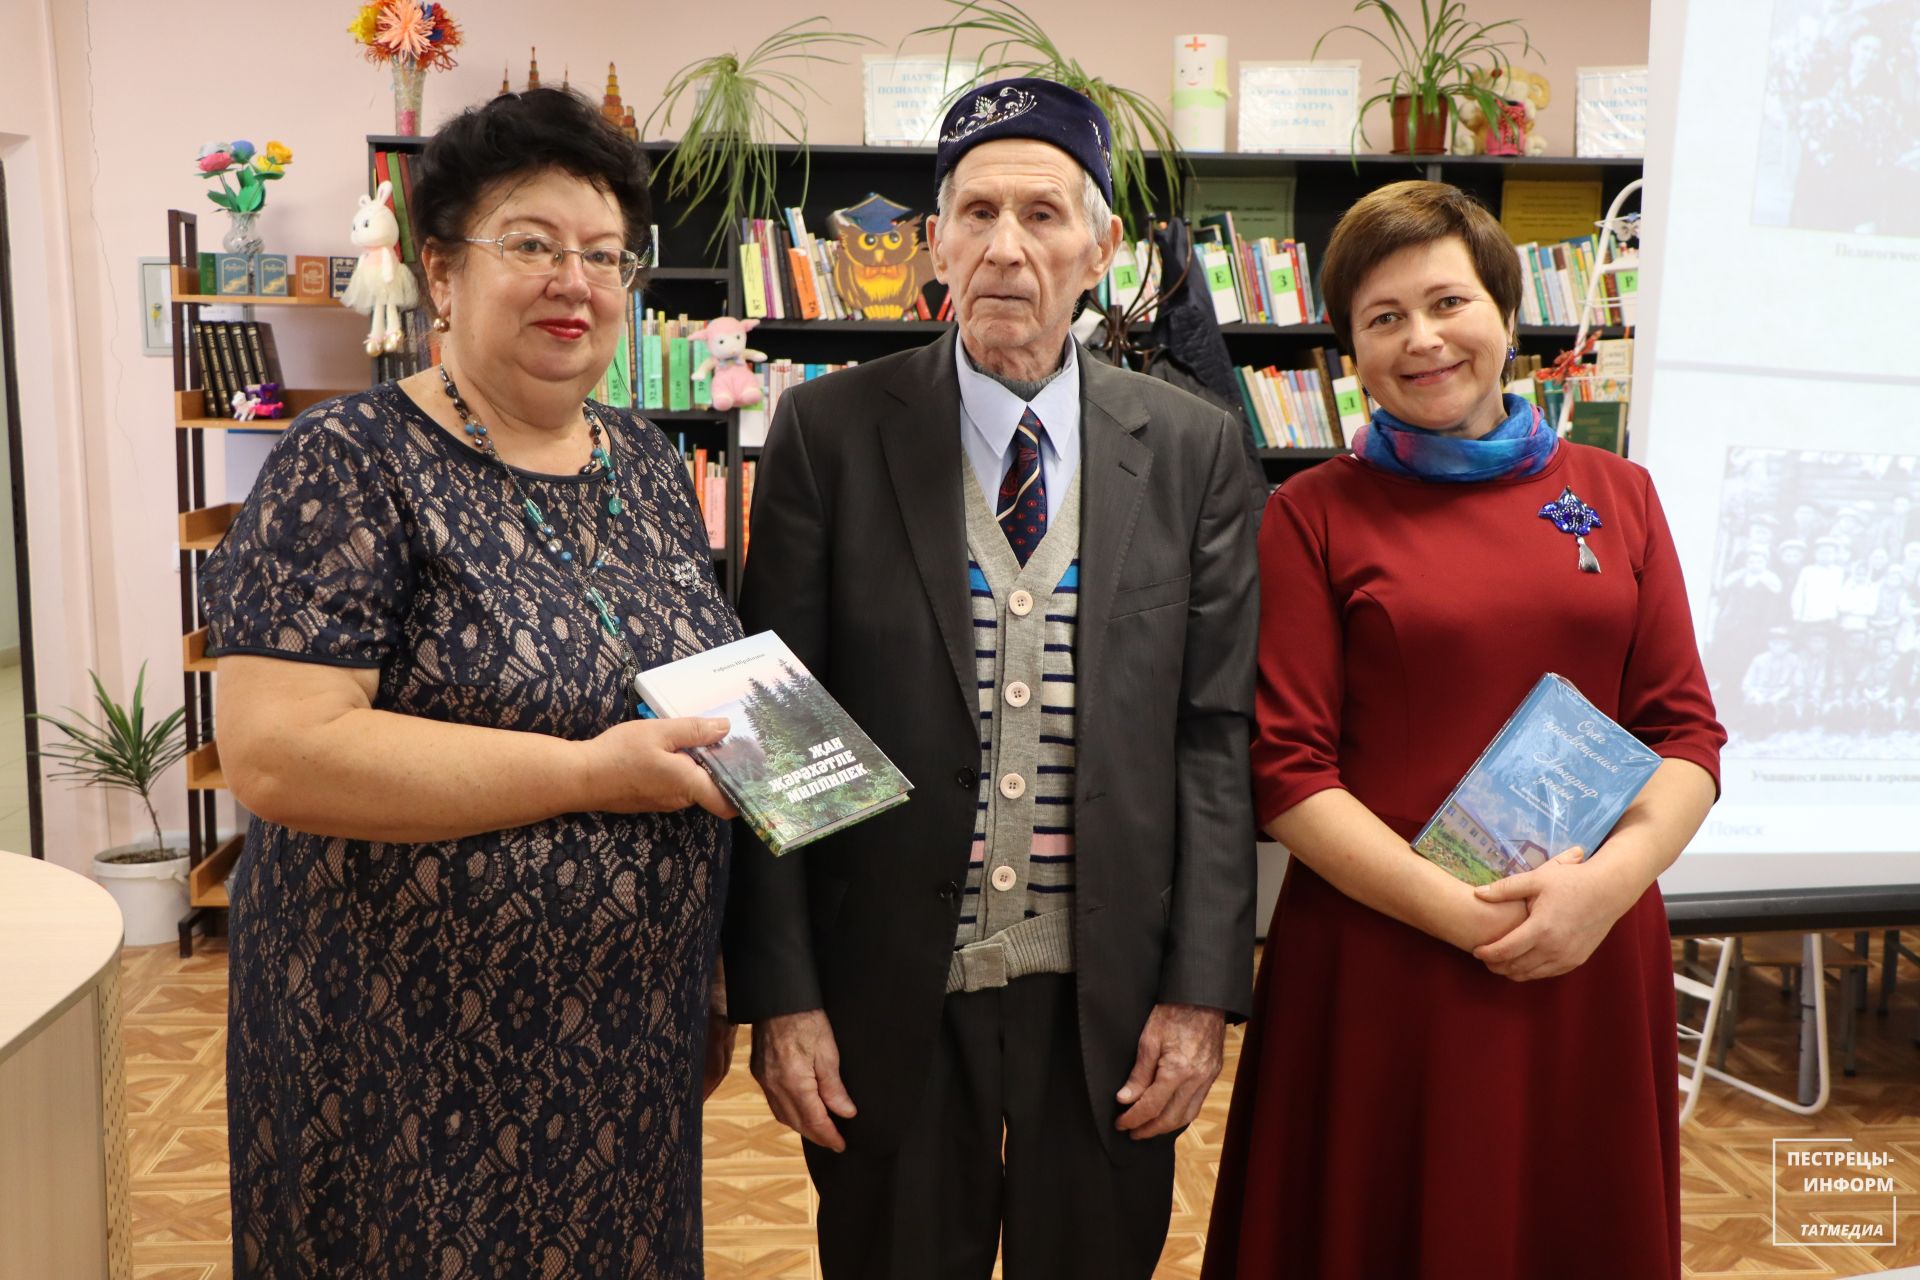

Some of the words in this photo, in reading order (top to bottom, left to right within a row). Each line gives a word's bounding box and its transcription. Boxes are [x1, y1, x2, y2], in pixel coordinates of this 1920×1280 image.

[1121, 271, 1133, 285] Д
[1215, 270, 1227, 284] Е
[787, 763, 869, 804] МИЛЛИЛЕК
[1708, 820, 1764, 837] Поиск
